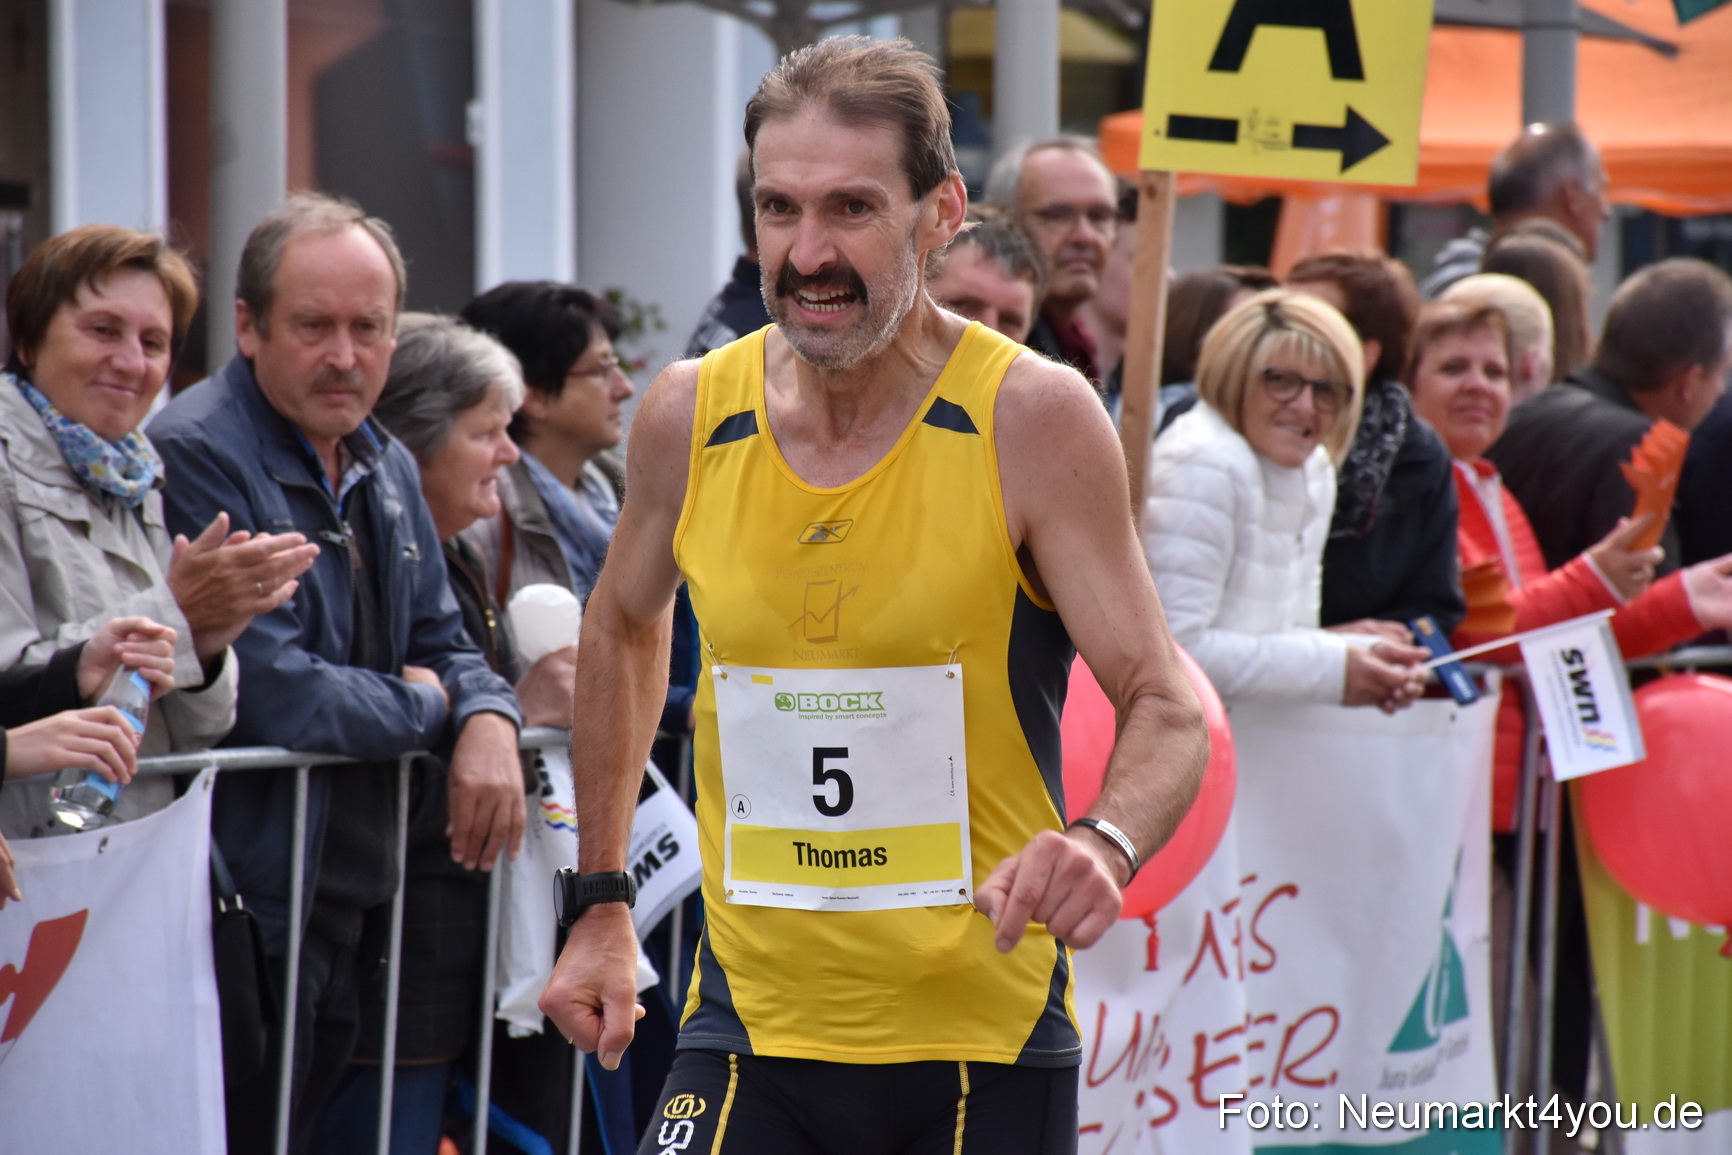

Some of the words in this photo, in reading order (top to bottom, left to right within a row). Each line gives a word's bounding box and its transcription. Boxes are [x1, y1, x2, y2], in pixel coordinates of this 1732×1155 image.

[797, 692, 885, 712] BOCK
[798, 712, 824, 721] inspired
[825, 713, 833, 721] by
[812, 746, 854, 817] 5
[737, 800, 746, 814] A
[793, 841, 888, 869] Thomas
